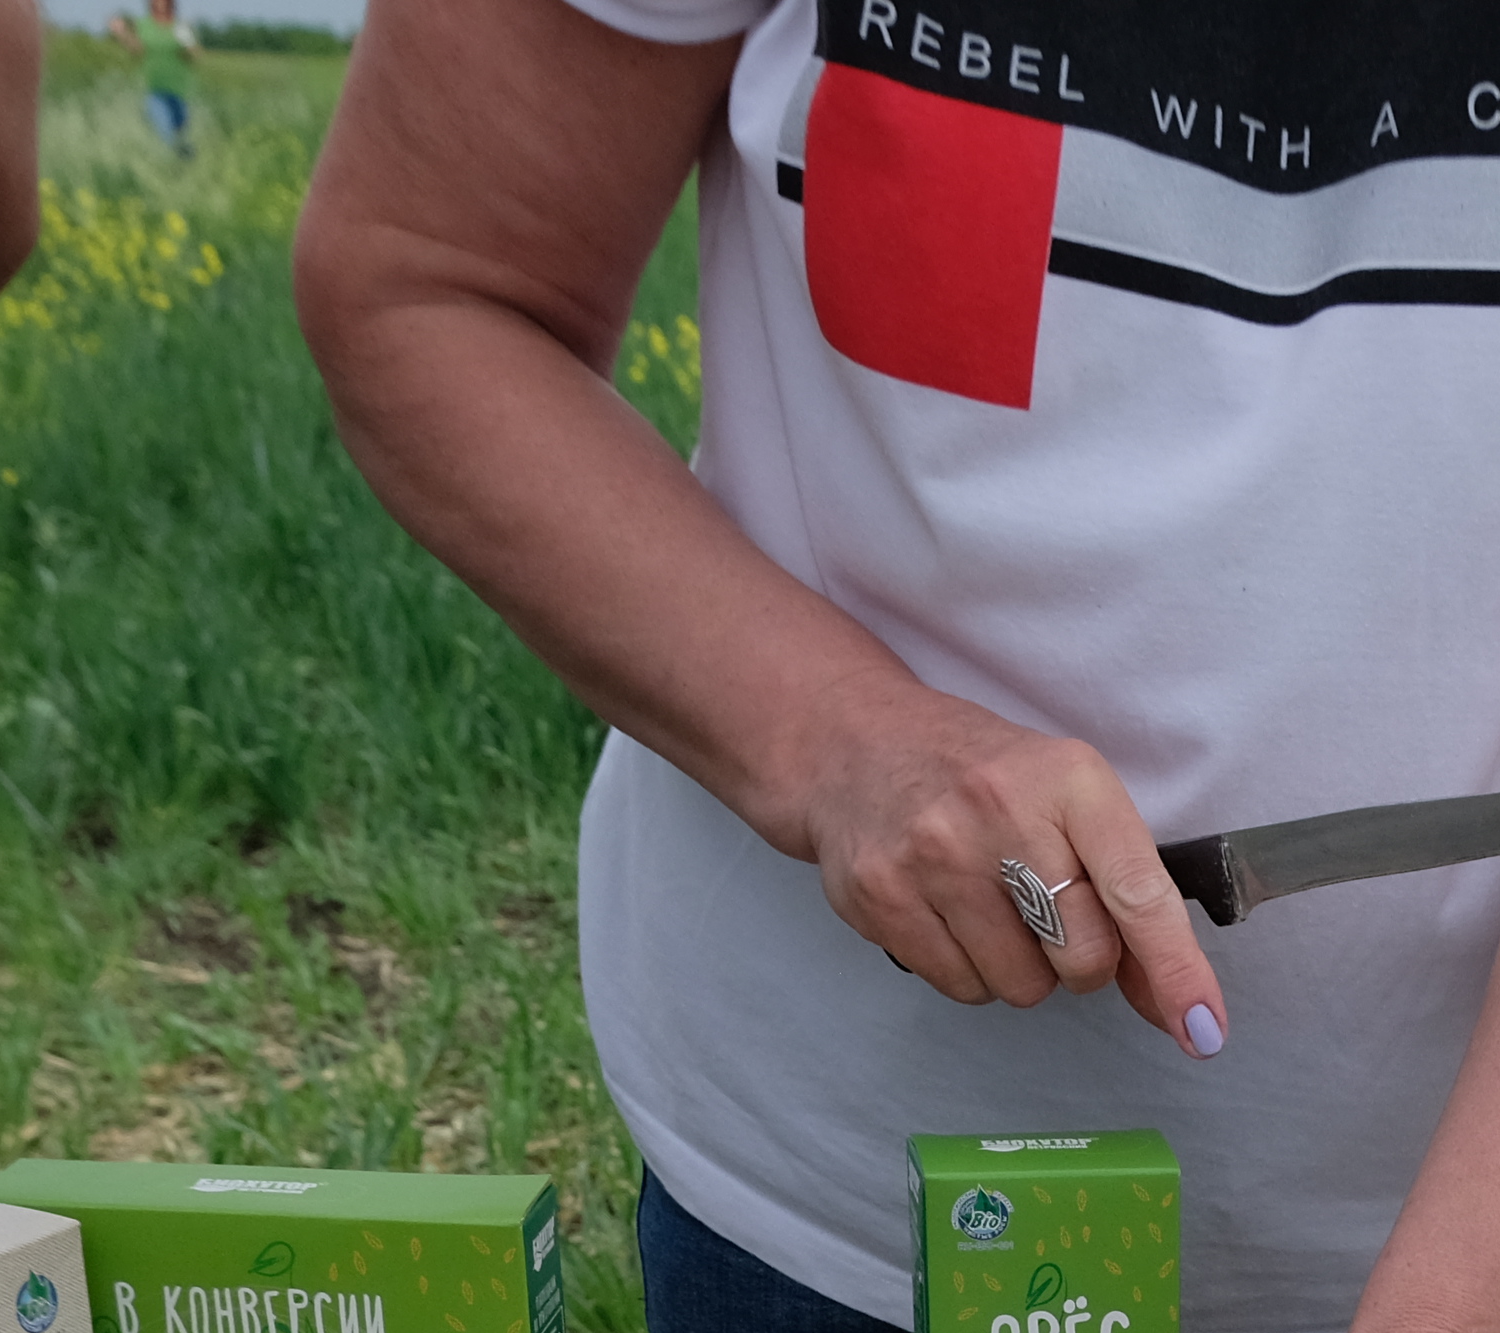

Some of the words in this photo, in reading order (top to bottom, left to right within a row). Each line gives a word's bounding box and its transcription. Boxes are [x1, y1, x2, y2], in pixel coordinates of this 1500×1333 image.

[858, 0, 1085, 103] REBEL
[1151, 89, 1312, 170] WITH
[1370, 101, 1401, 148] A
[969, 1210, 999, 1229] Bio
